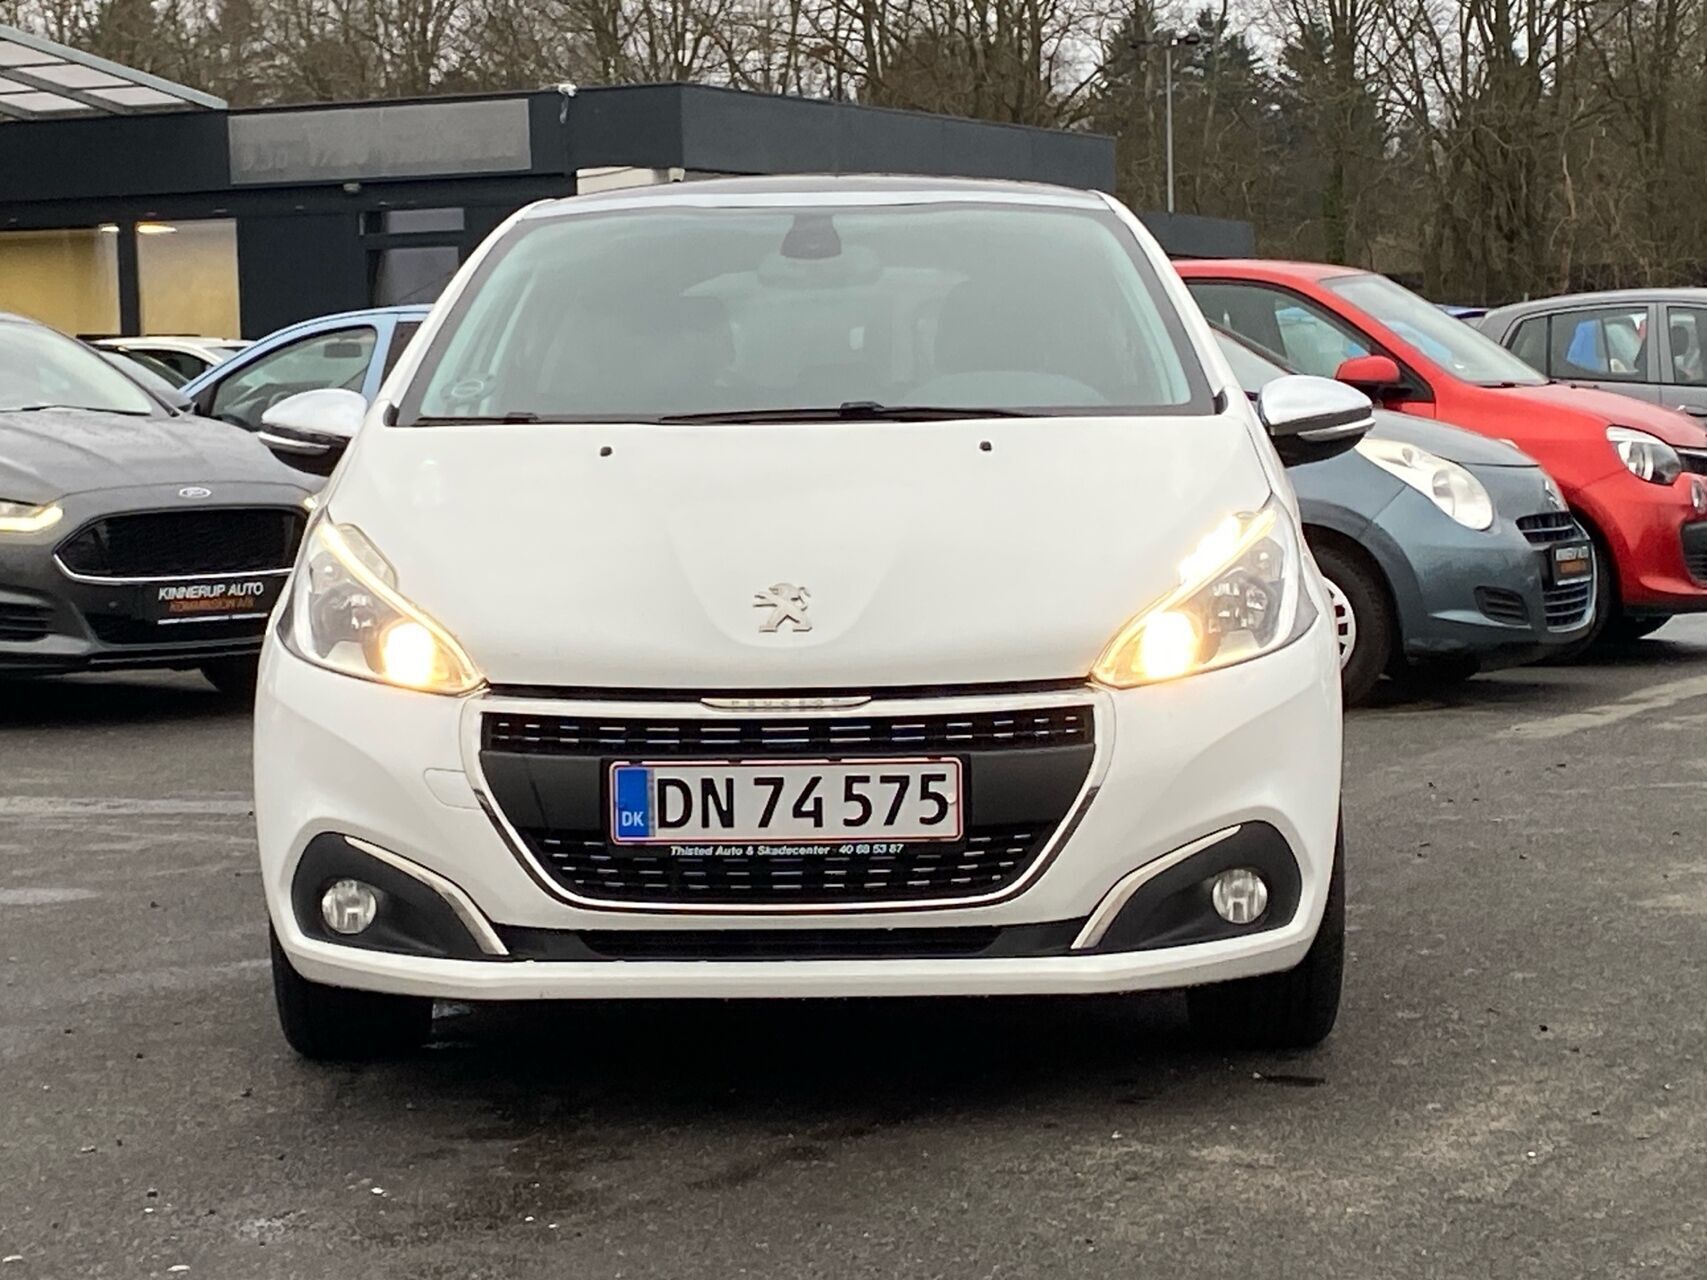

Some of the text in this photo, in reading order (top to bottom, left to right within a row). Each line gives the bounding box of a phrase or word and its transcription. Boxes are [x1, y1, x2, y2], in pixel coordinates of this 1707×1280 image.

[158, 582, 264, 601] KINNERUP AUTO
[656, 772, 949, 829] DN 74 575
[621, 810, 645, 828] DK
[670, 845, 714, 856] Thisted
[715, 845, 743, 856] Auto
[745, 845, 754, 856] &
[757, 844, 831, 856] Skadecenter
[838, 844, 854, 855] 40
[888, 843, 905, 854] 87
